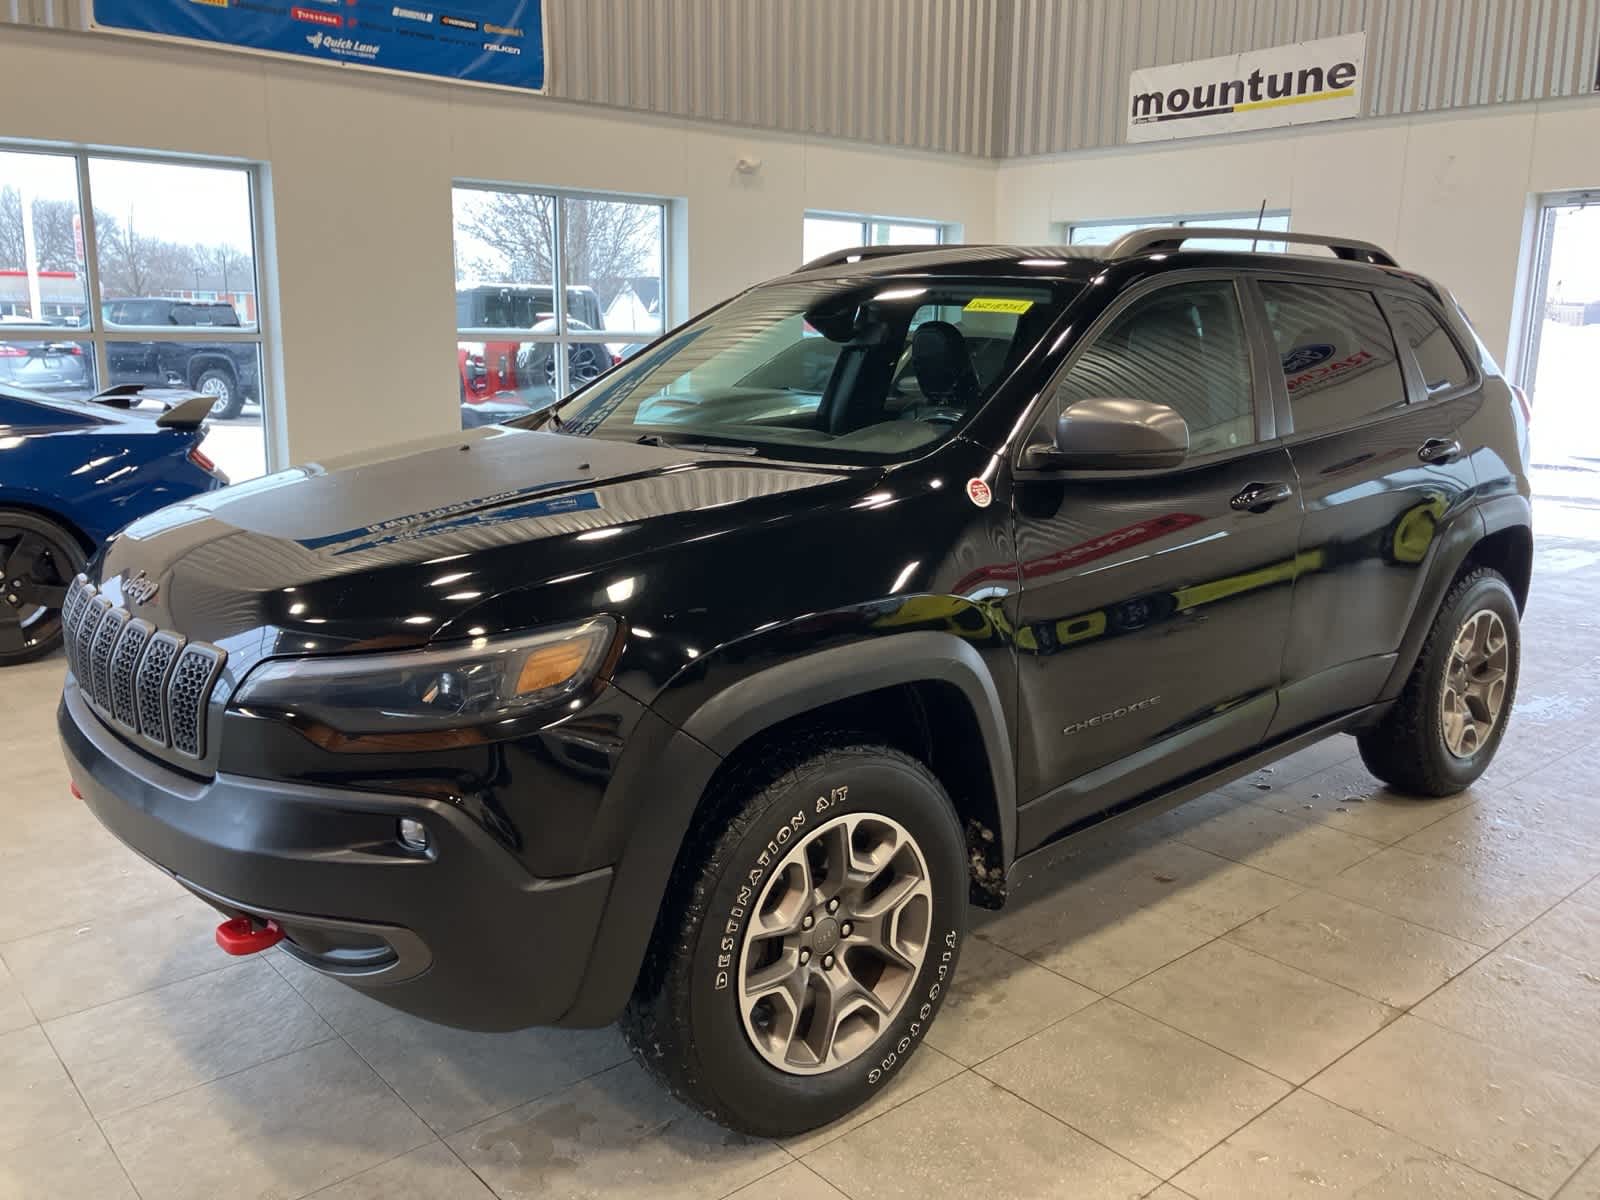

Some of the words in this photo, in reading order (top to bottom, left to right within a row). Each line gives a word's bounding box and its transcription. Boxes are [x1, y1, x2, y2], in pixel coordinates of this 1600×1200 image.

[323, 35, 353, 50] Quick
[353, 41, 381, 54] Lane
[1132, 62, 1357, 118] mountune
[122, 569, 159, 605] Jeep
[1063, 695, 1161, 736] CHEROKEE
[715, 810, 806, 990] DESTINATION
[816, 785, 849, 813] A/T
